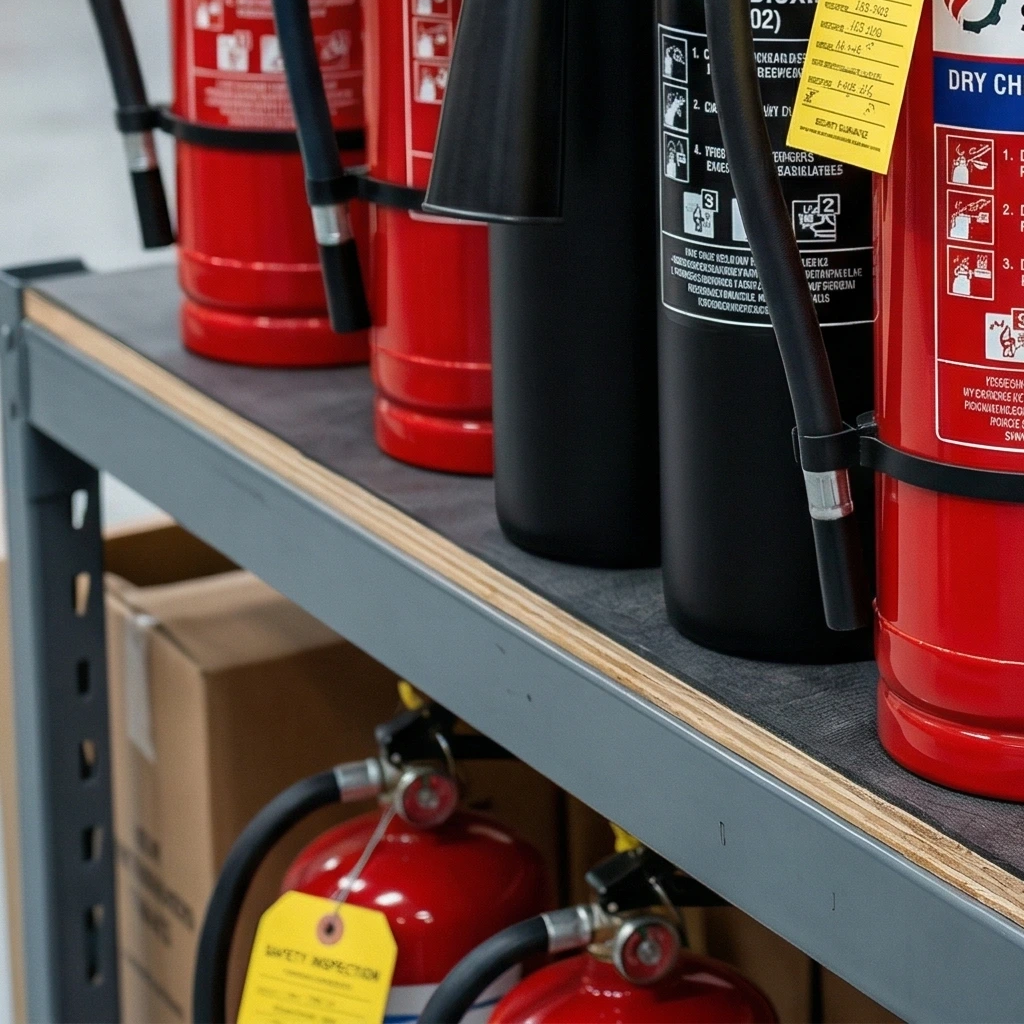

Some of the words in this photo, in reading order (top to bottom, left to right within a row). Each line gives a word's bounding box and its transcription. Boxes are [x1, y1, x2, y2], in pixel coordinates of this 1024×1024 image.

[948, 68, 988, 93] DRY
[1002, 148, 1014, 161] 1.
[1002, 203, 1014, 216] 2.
[1002, 257, 1014, 270] 3.
